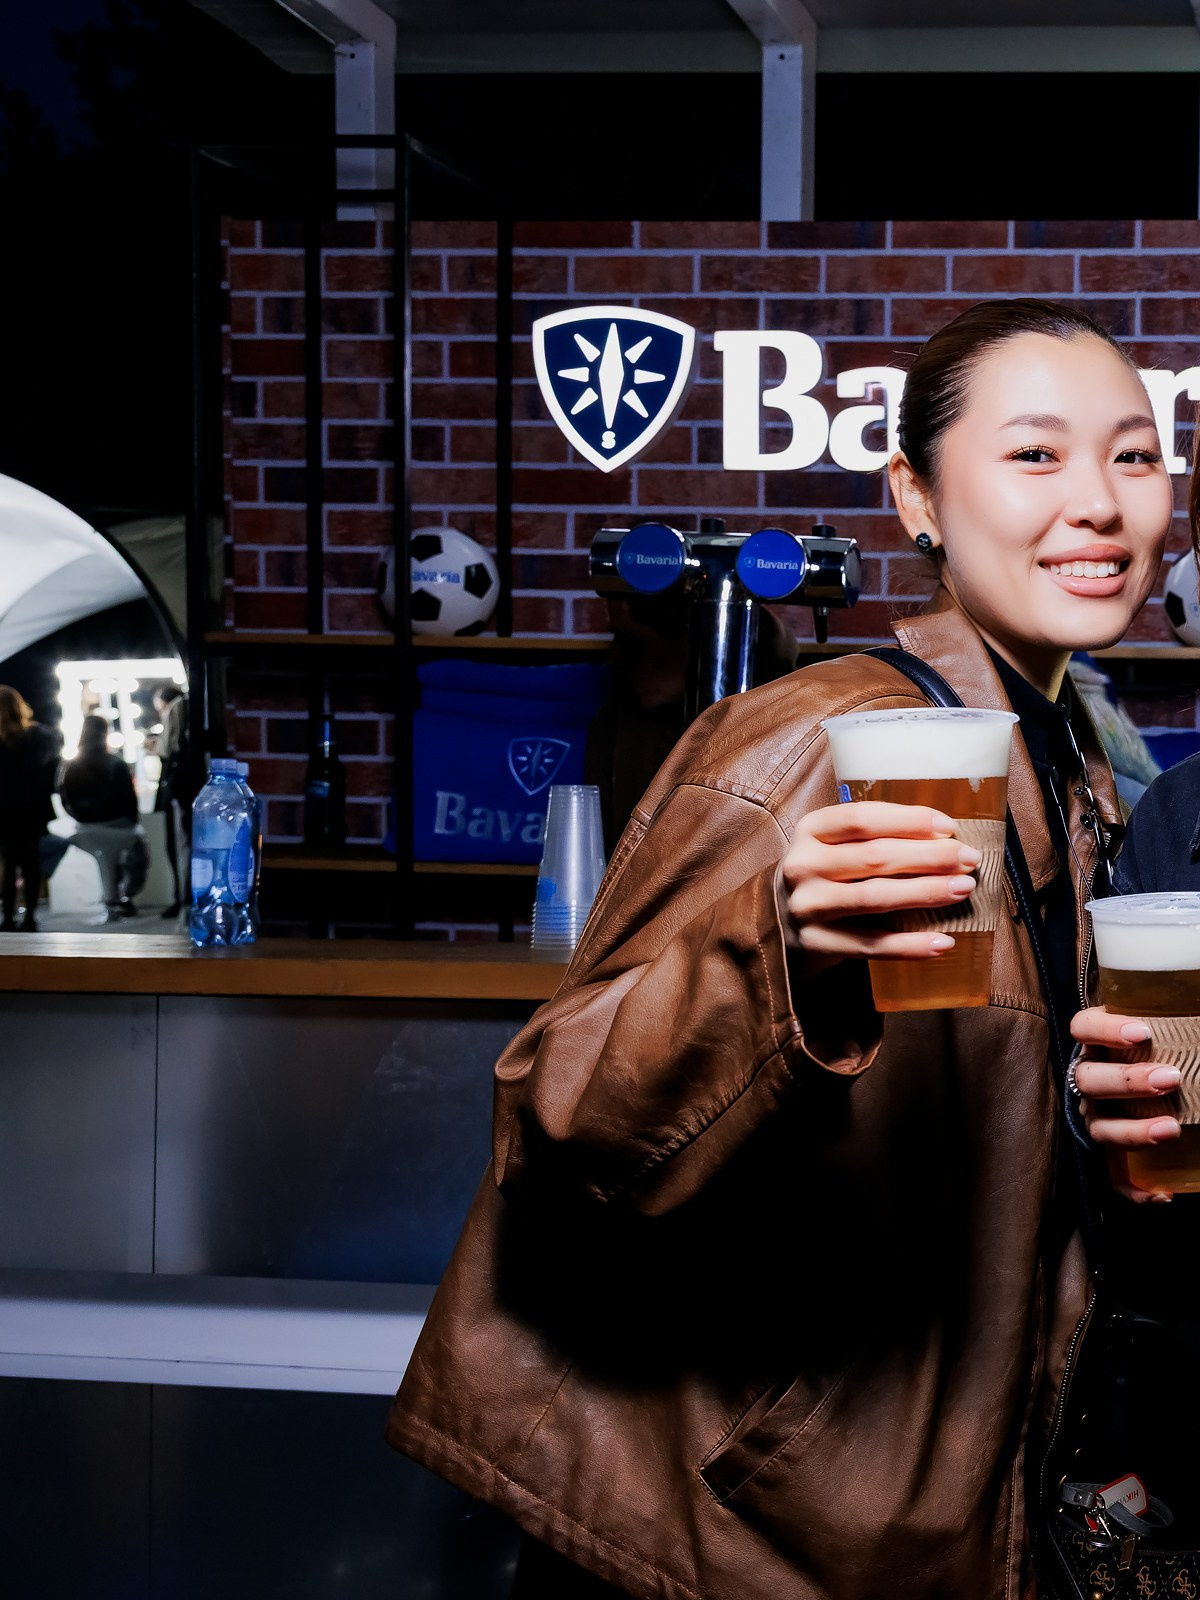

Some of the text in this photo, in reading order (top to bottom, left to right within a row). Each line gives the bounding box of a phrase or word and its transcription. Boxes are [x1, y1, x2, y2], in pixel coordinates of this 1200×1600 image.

[636, 554, 680, 566] Bavaria
[756, 559, 799, 570] Bavaria
[434, 790, 547, 846] Bava
